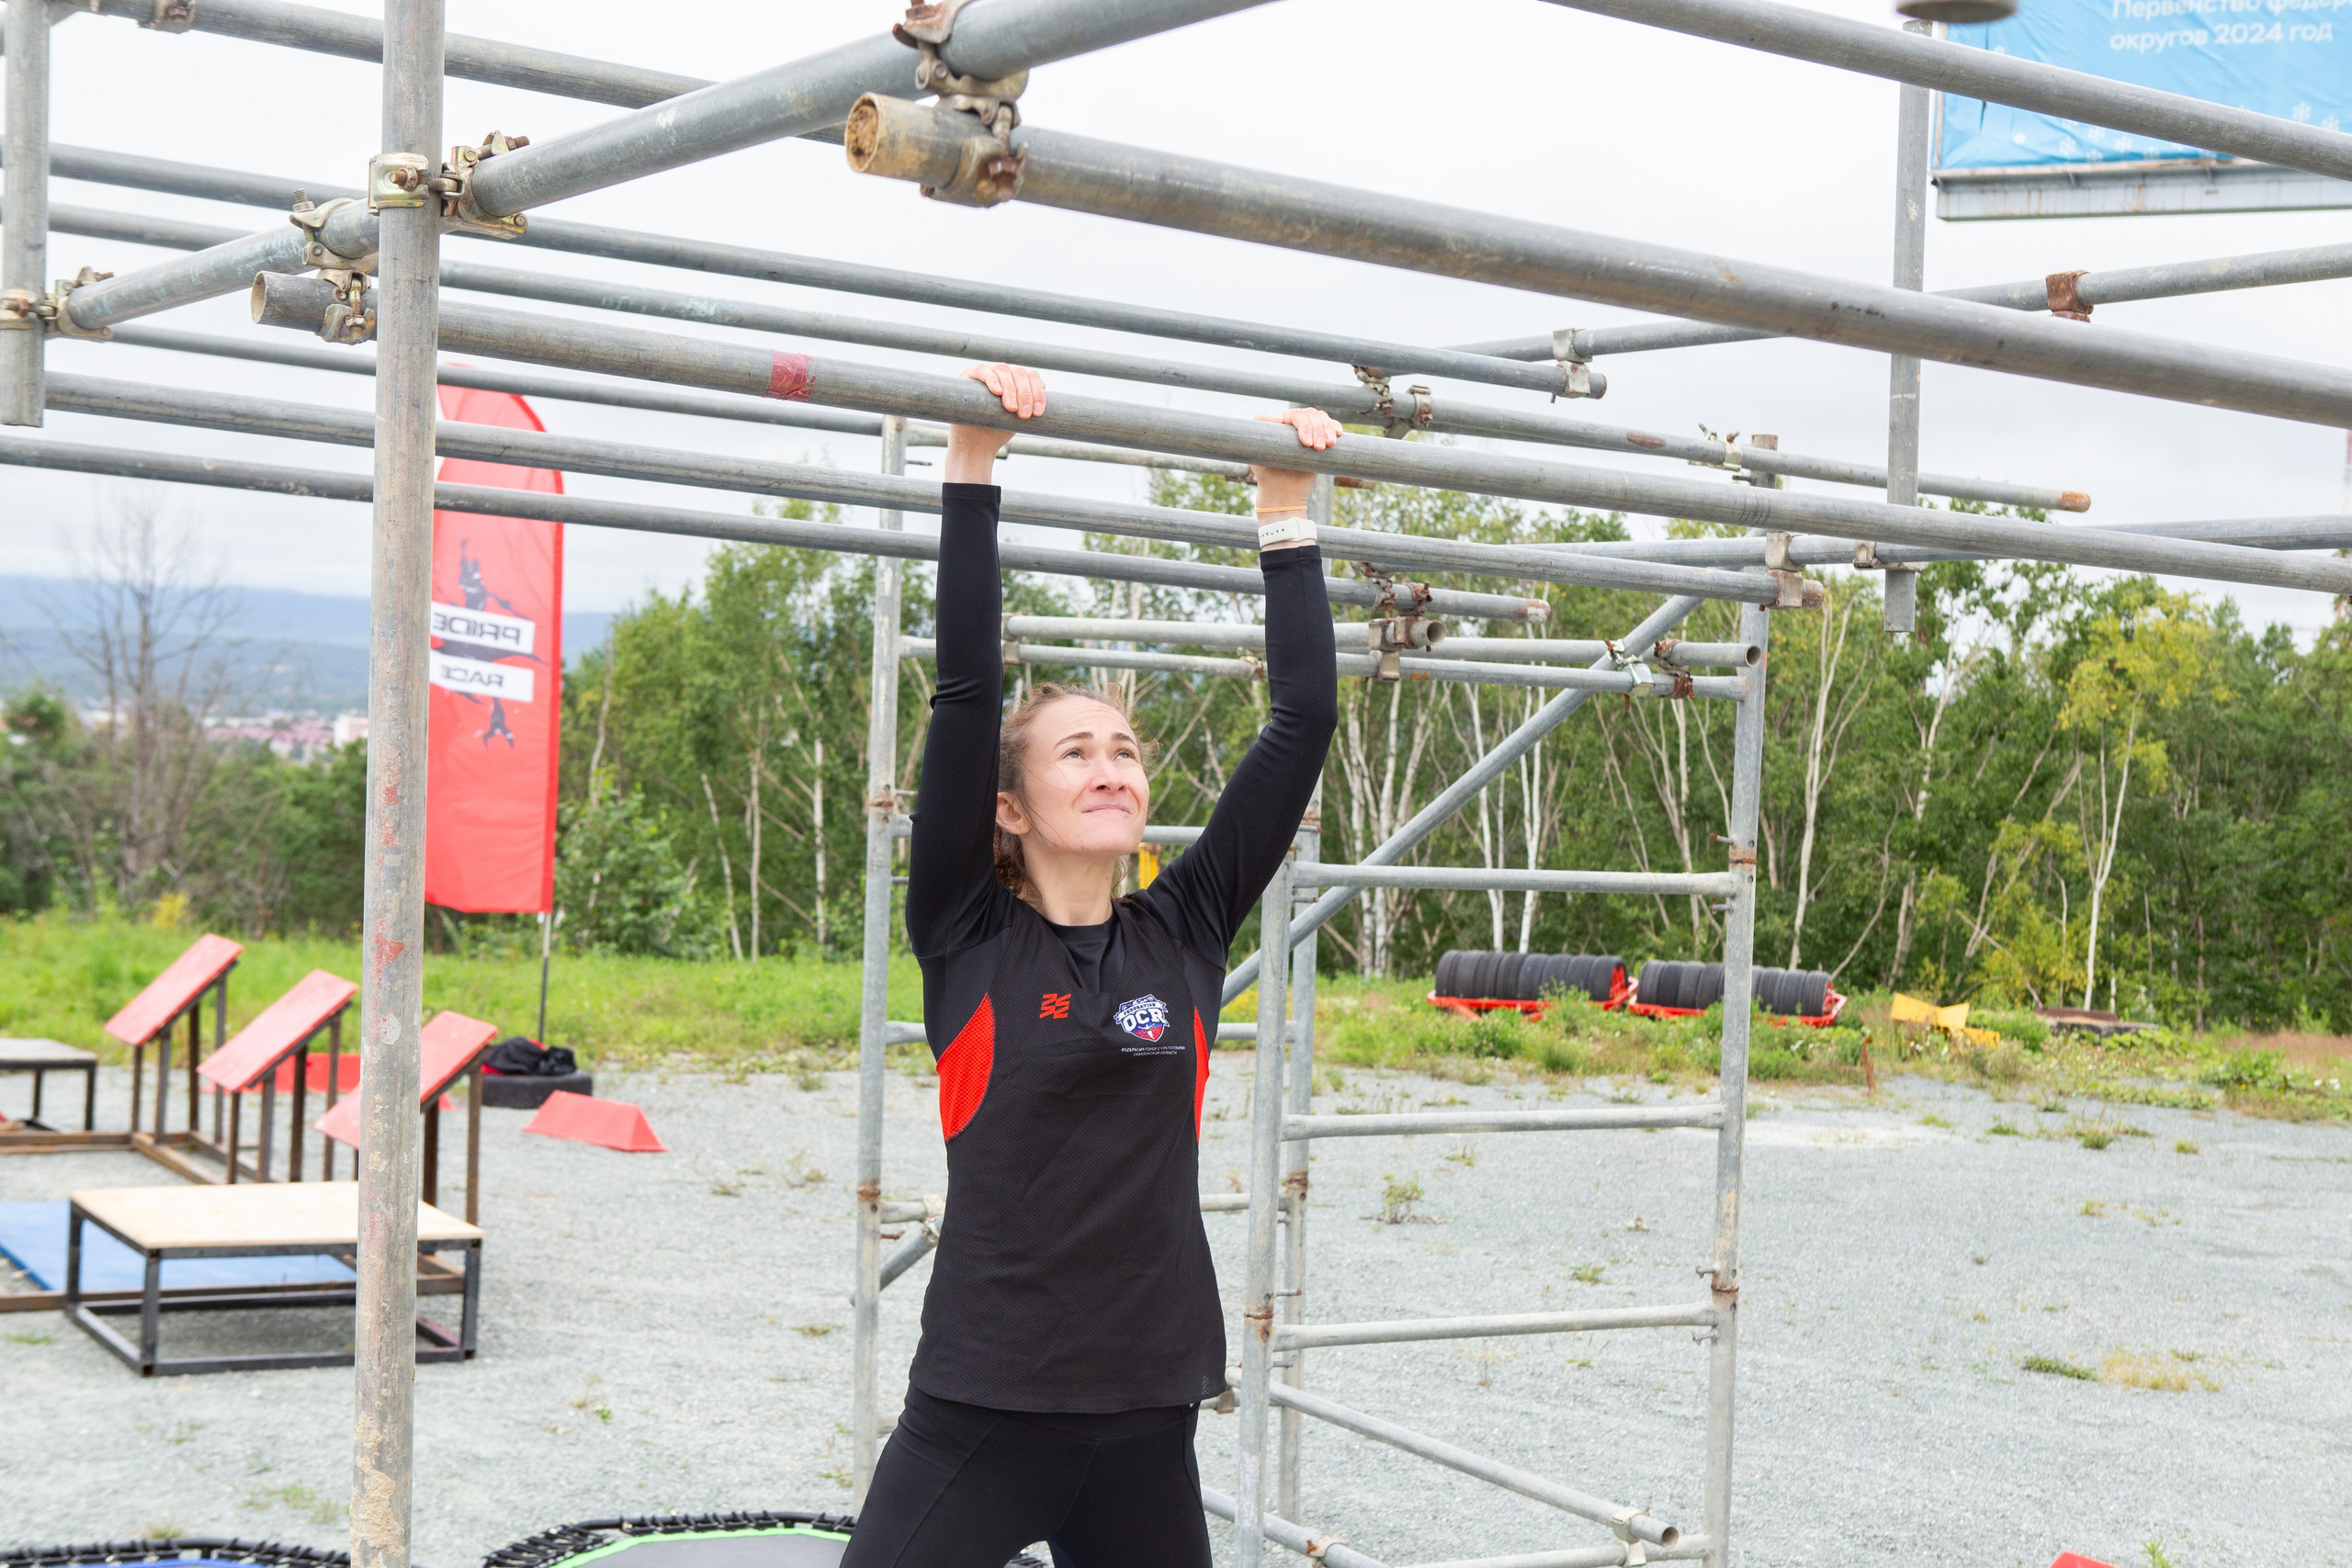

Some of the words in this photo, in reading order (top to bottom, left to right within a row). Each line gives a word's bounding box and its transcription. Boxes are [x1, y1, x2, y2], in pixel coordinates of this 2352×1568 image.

[2112, 0, 2261, 22] Первенство
[2267, 0, 2352, 16] федр
[2109, 28, 2209, 53] округов
[2214, 22, 2284, 45] 2024
[2289, 22, 2334, 44] год
[1123, 1008, 1168, 1032] OCR
